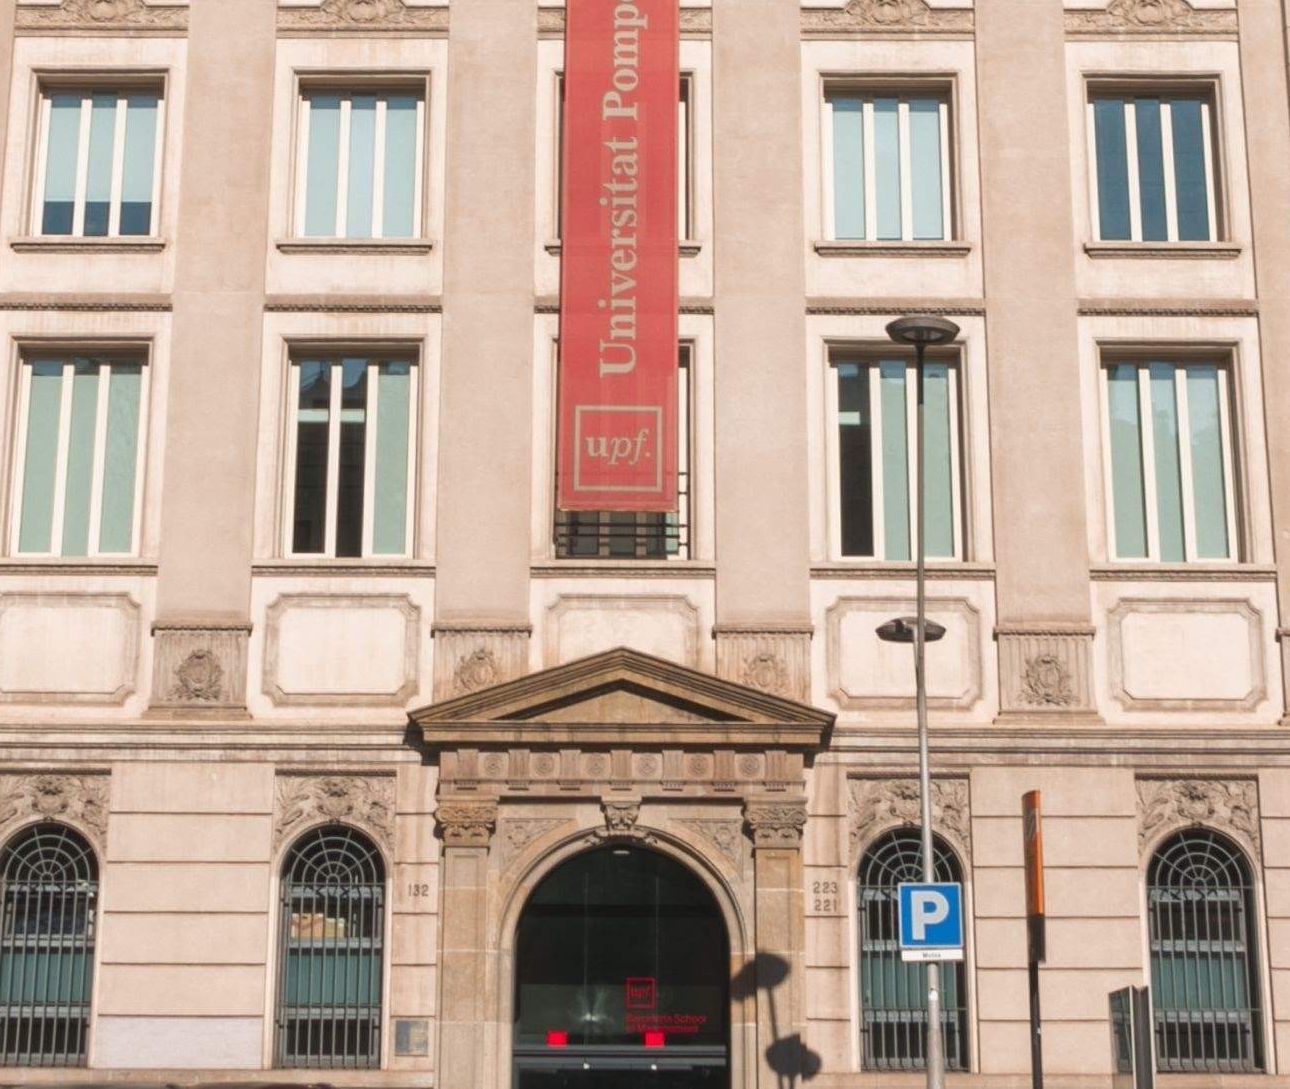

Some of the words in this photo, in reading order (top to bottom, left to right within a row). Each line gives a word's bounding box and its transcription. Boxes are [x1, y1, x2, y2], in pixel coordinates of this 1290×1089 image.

[598, 136, 639, 379] Universitat
[408, 884, 429, 897] 132
[813, 881, 838, 894] 223
[814, 899, 838, 912] 221
[910, 890, 949, 941] P
[674, 1013, 707, 1024] School
